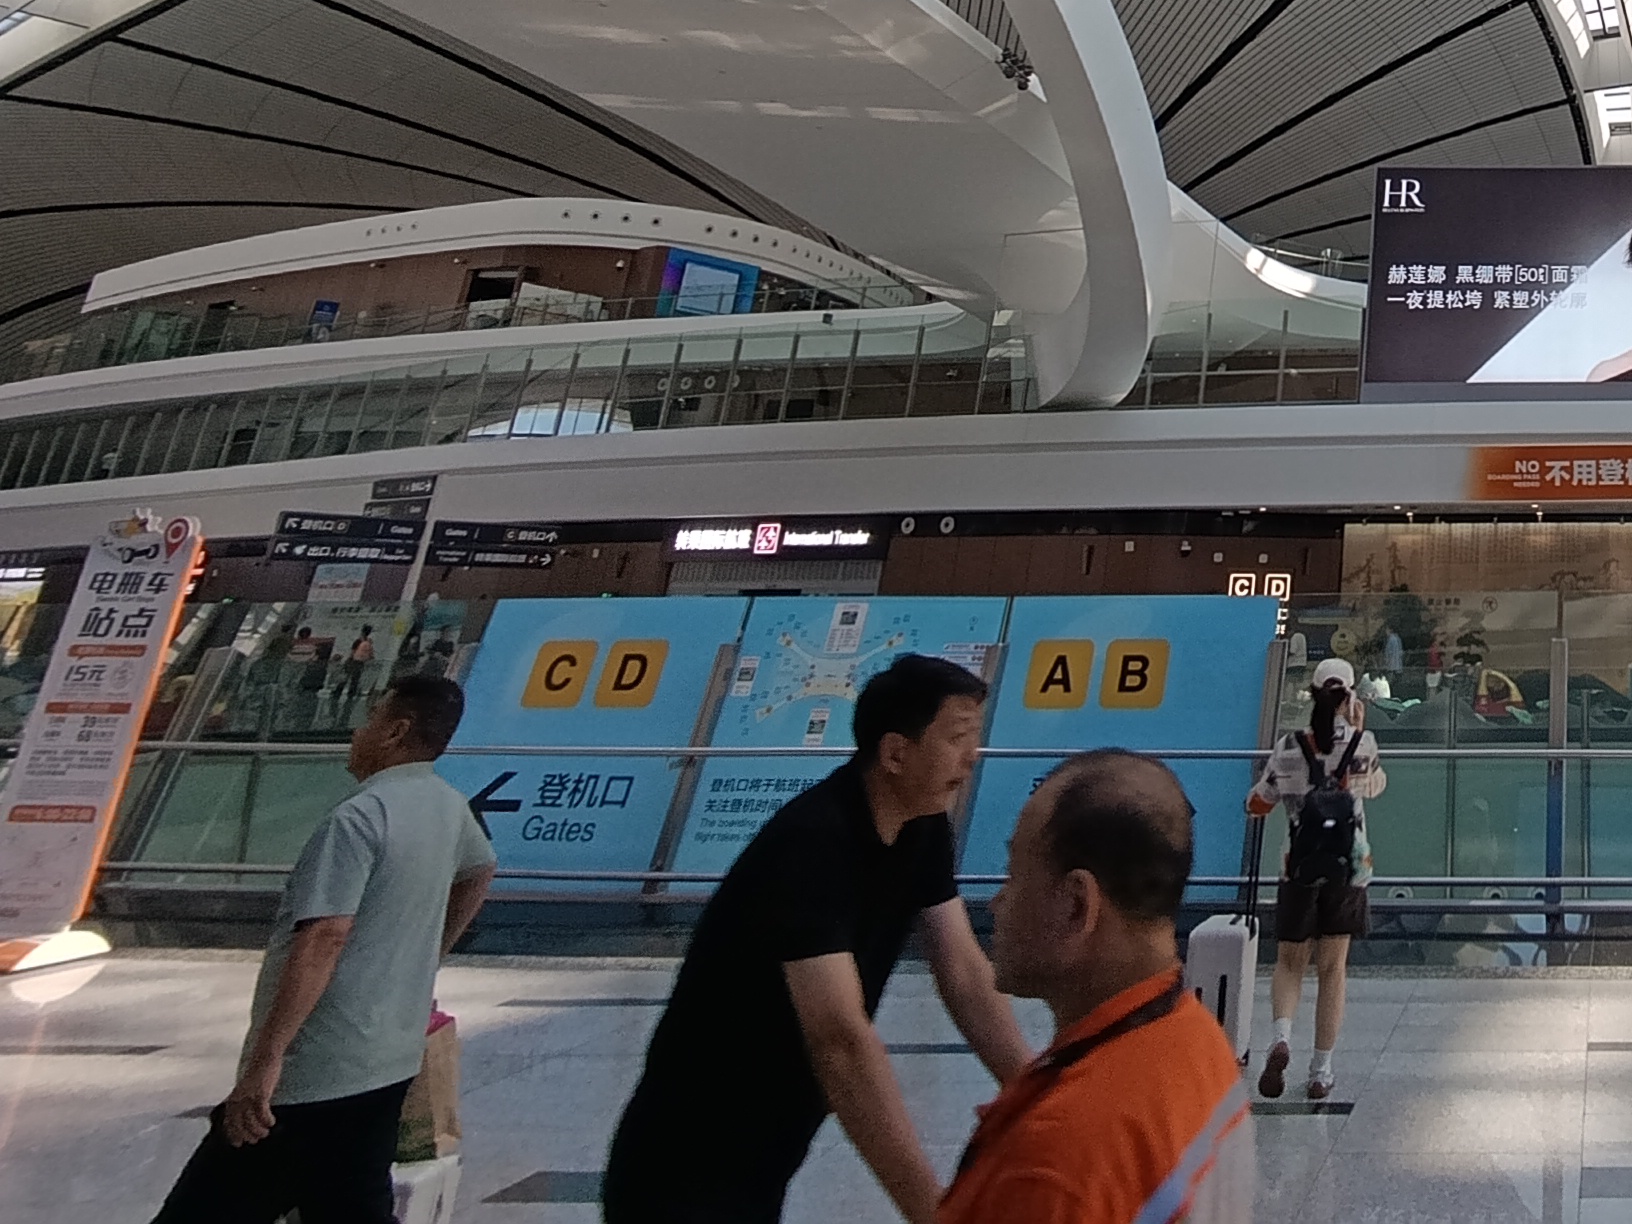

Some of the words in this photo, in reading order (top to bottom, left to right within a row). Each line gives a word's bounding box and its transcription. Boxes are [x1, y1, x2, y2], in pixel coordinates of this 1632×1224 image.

[1382, 178, 1425, 208] HR
[1387, 264, 1447, 284] 赫莲娜
[1386, 290, 1483, 309] 一夜提松垮
[1515, 460, 1540, 473] NO
[88, 572, 175, 594] 电瓶车
[1234, 579, 1250, 596] C
[1270, 579, 1285, 596] D
[78, 607, 158, 637] 站点
[64, 664, 107, 682] 15元
[544, 653, 577, 692] C
[612, 653, 648, 691] D
[1039, 654, 1072, 693] A
[1117, 654, 1150, 693] B
[531, 772, 635, 809] 登机口
[710, 778, 824, 792] 登机口将于航班起
[521, 814, 597, 842] Gates
